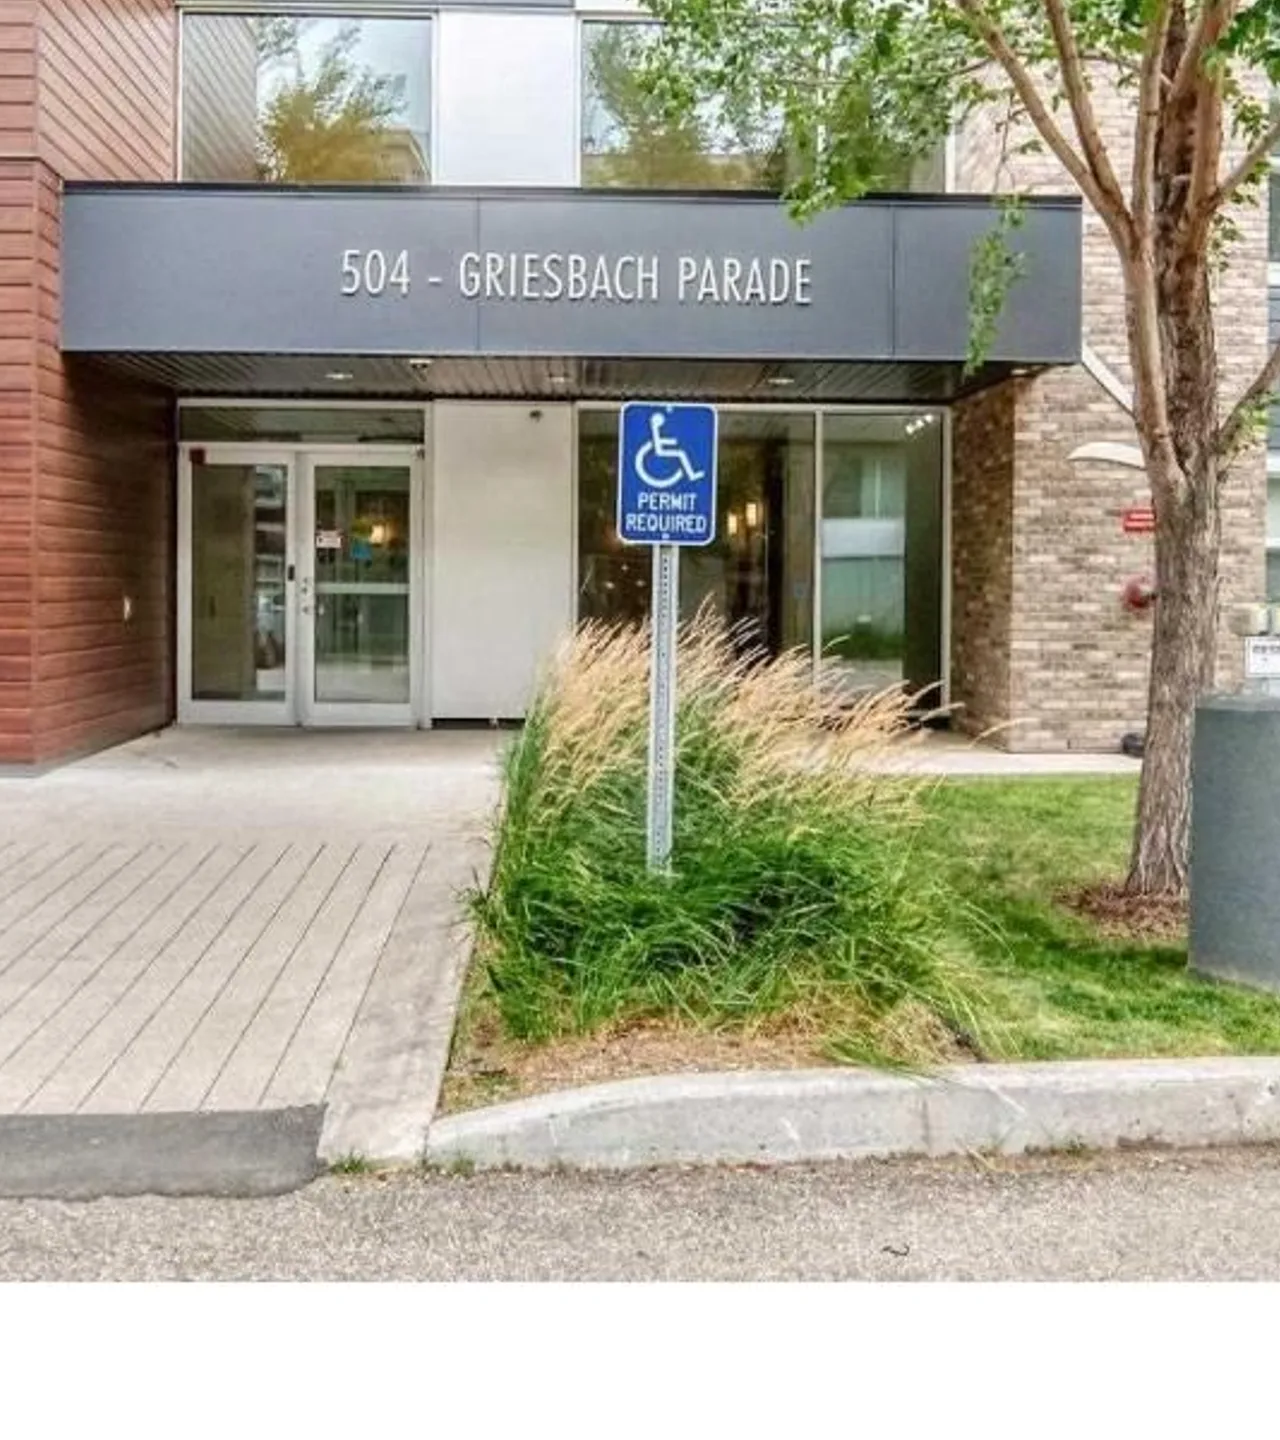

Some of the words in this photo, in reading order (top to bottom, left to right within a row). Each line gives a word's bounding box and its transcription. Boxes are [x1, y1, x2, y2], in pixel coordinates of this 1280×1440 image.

[339, 248, 411, 296] 504
[458, 252, 659, 301] GRIESBACH
[677, 257, 813, 305] PARADE
[637, 491, 698, 511] PERMIT
[625, 512, 707, 534] REQUIRED
